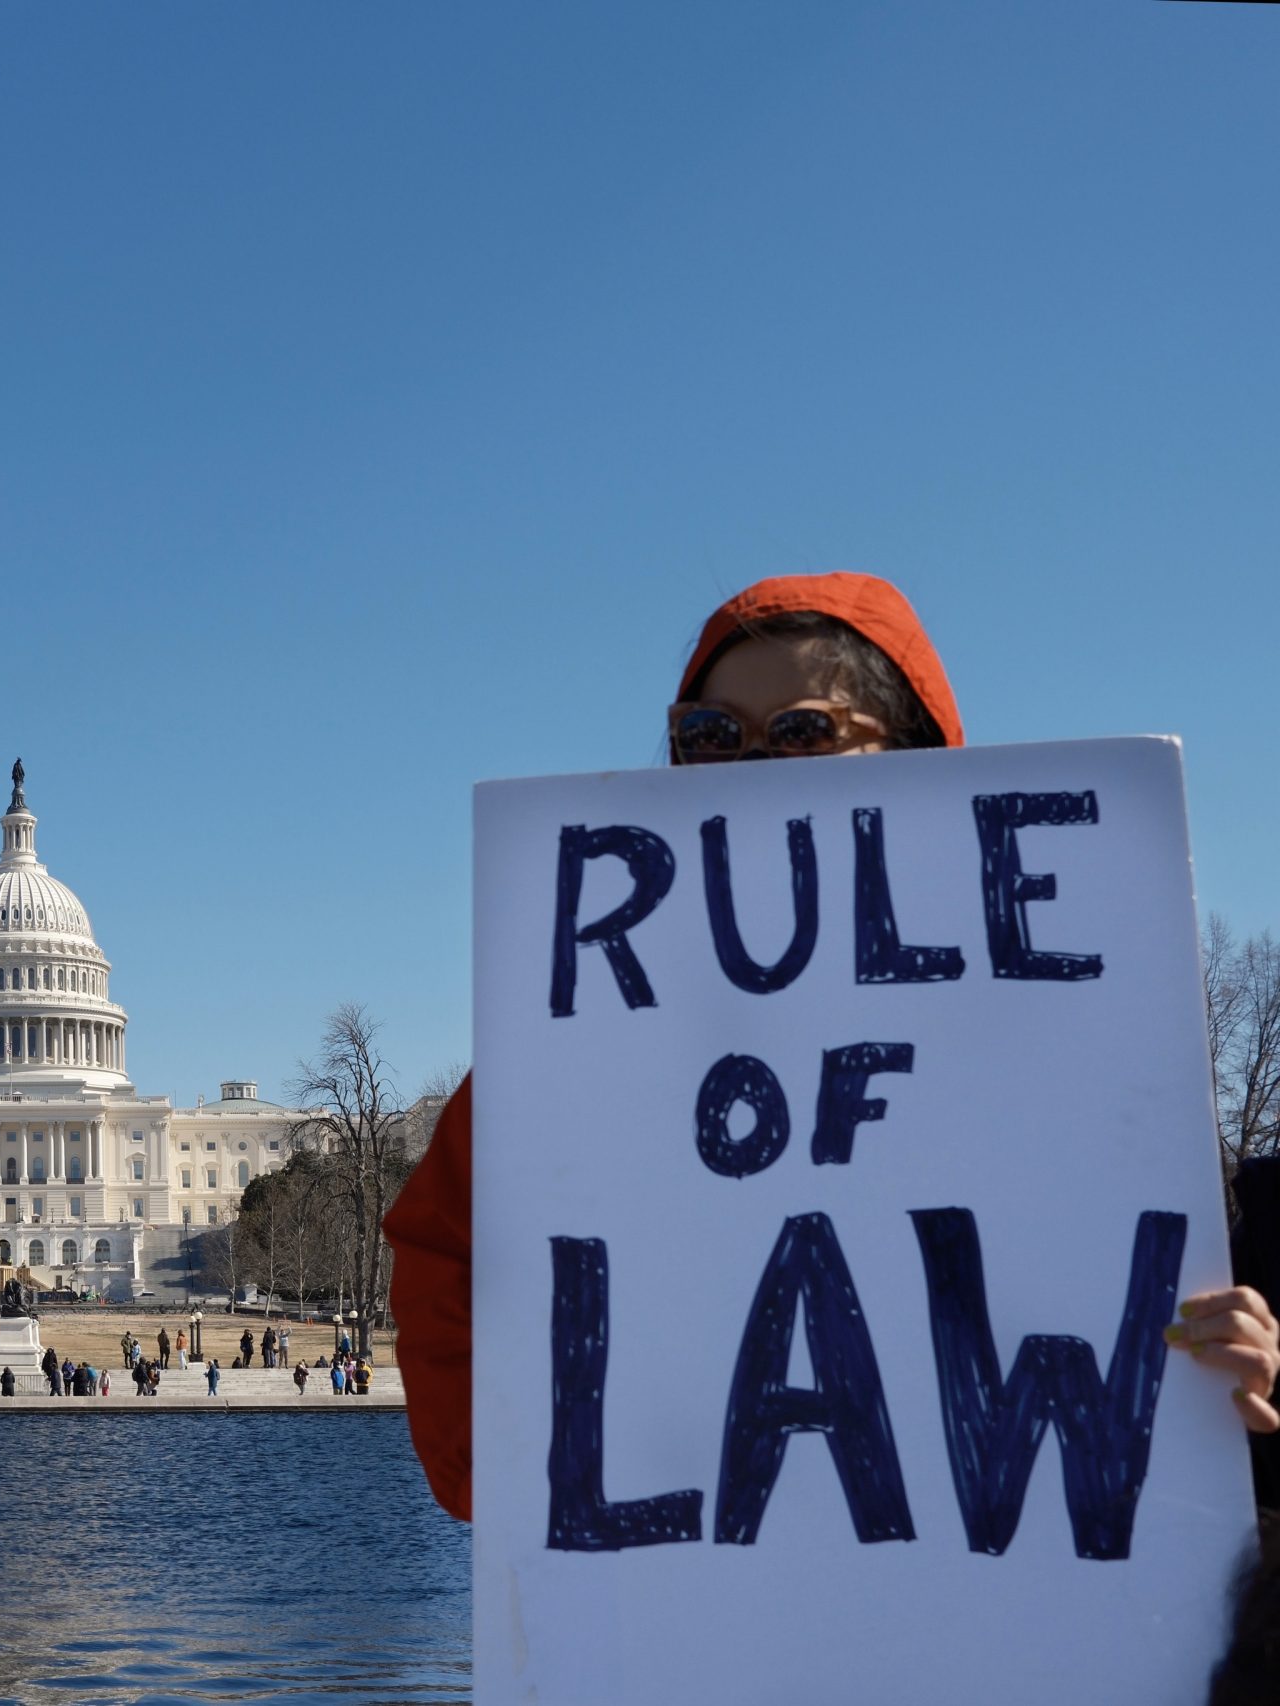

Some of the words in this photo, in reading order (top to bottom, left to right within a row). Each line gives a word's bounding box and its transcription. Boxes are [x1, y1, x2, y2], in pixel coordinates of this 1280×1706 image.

[549, 790, 1104, 1018] RULE
[694, 1041, 914, 1179] OF
[546, 1206, 1188, 1560] LAW
